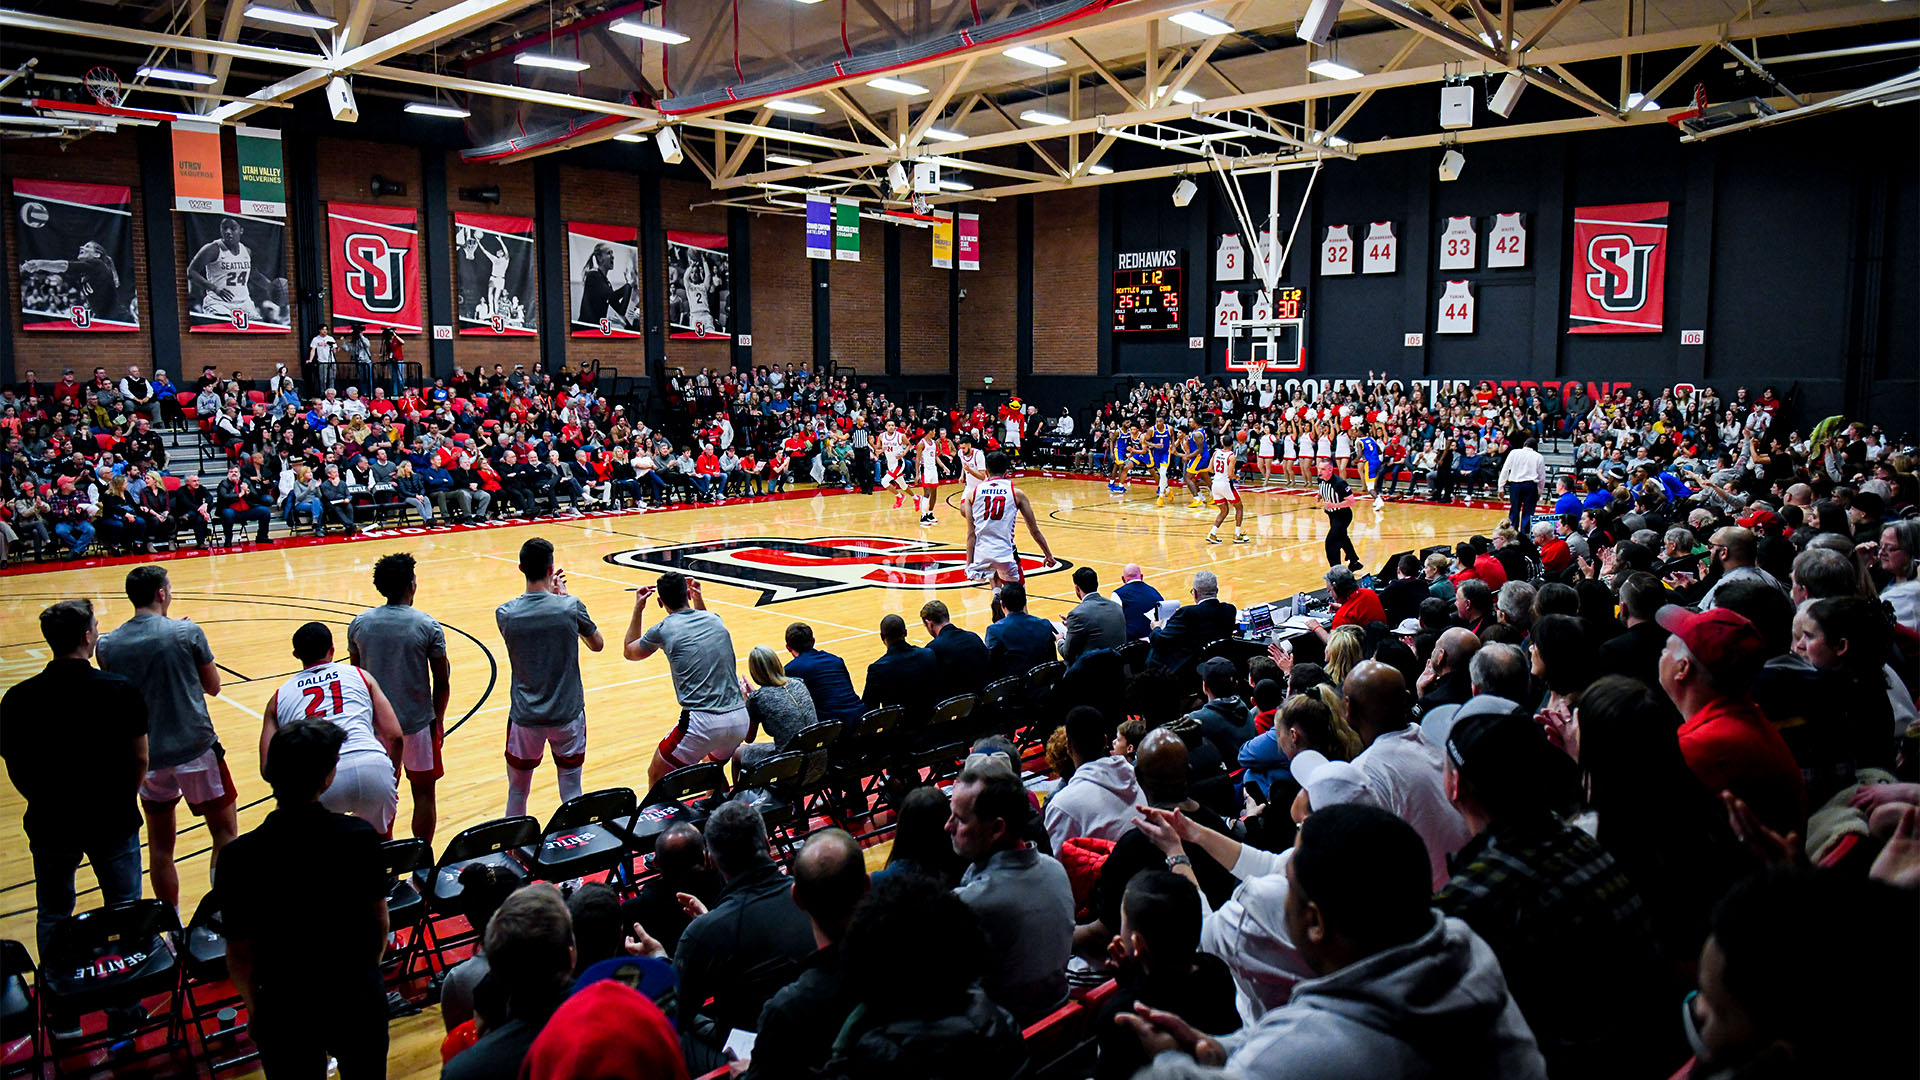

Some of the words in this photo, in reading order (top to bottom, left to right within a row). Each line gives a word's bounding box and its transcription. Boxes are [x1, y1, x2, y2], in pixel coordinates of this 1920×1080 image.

[242, 166, 258, 175] UTAH
[259, 167, 281, 176] VALLEY
[242, 175, 282, 184] WOLVERINES
[188, 200, 212, 210] WAC
[252, 204, 275, 214] WAC
[1370, 244, 1390, 260] 44
[1448, 239, 1470, 256] 33
[1496, 236, 1519, 253] 42
[1119, 250, 1176, 269] REDHAWKS
[1226, 254, 1235, 269] 3
[1328, 246, 1348, 263] 32
[226, 271, 247, 286] 24
[344, 232, 410, 313] SU
[1142, 270, 1162, 284] 1:12
[1585, 233, 1658, 312] SU
[696, 292, 703, 304] 2
[1119, 295, 1133, 308] 25
[1146, 296, 1150, 306] 1
[1163, 293, 1178, 307] 25
[1172, 311, 1177, 322] 7
[1220, 310, 1238, 325] 20
[1279, 301, 1298, 319] 30
[1446, 303, 1468, 320] 44
[1118, 314, 1124, 324] 4
[436, 329, 450, 338] 102
[1684, 334, 1700, 343] 106
[1216, 460, 1225, 473] 23
[984, 496, 1006, 520] 10
[298, 671, 338, 687] DALLAS
[303, 680, 343, 718] 21
[546, 832, 597, 849] SEATTLE
[74, 952, 147, 979] SEATTLE
